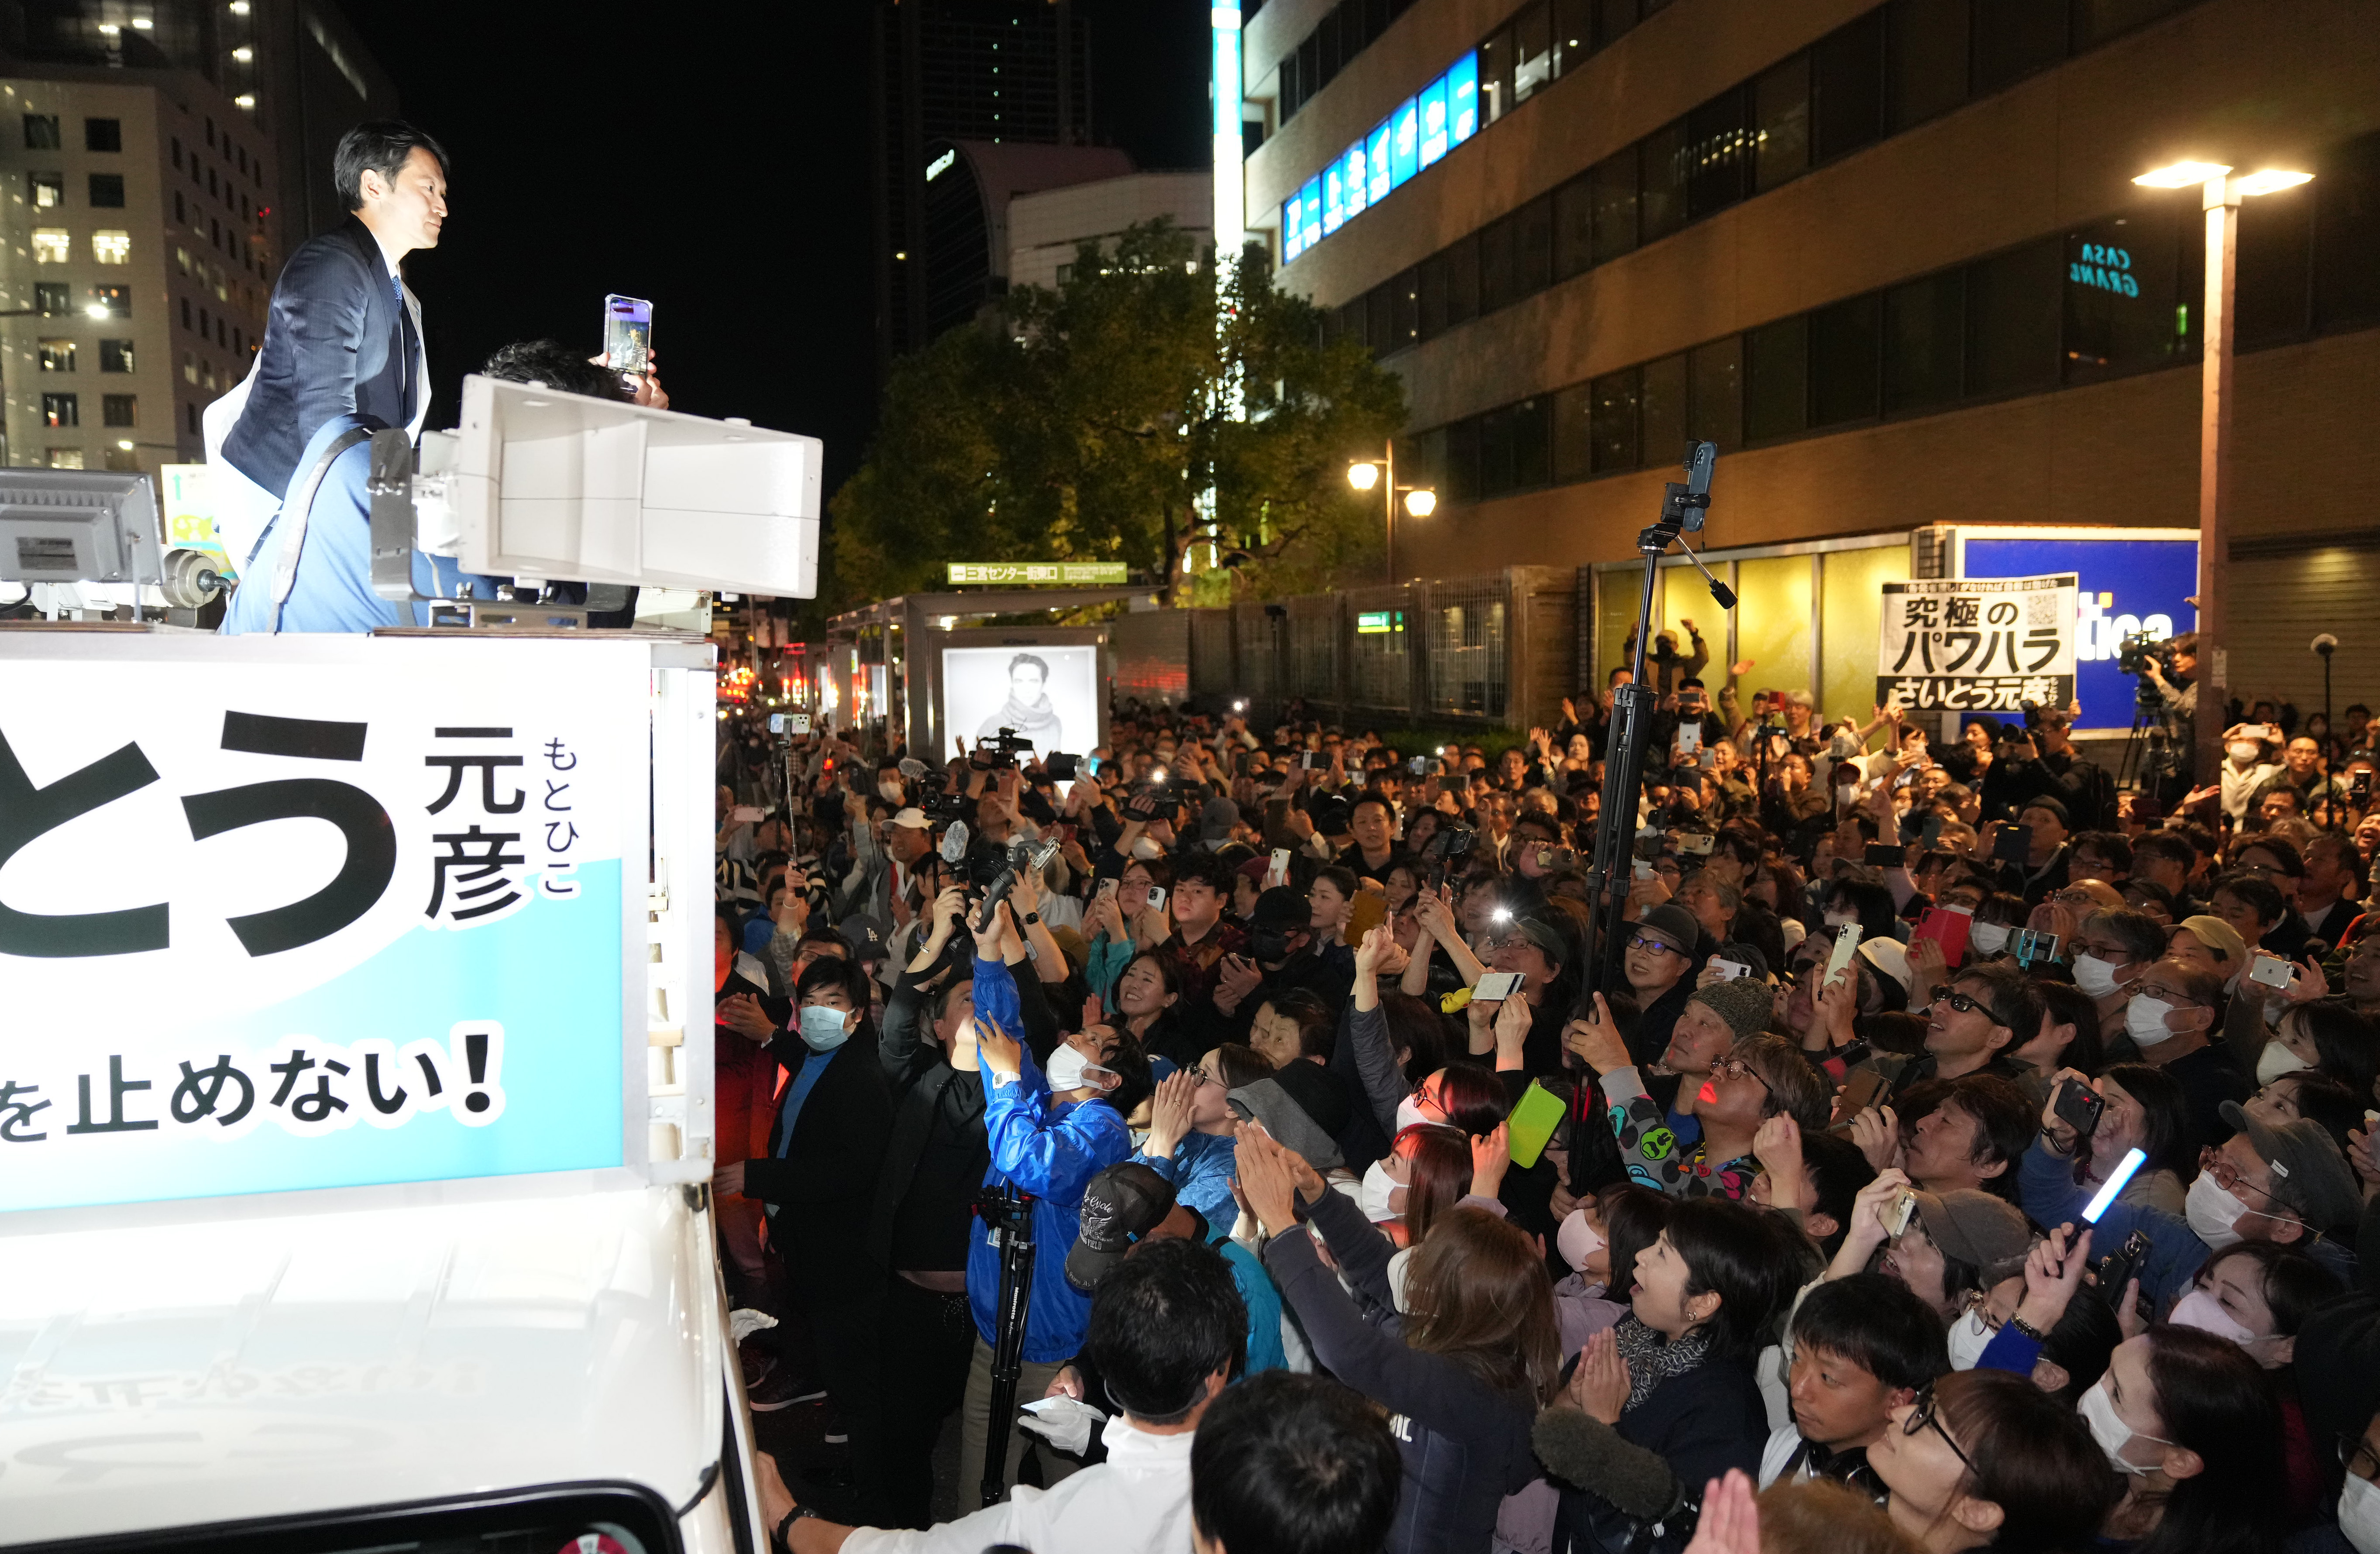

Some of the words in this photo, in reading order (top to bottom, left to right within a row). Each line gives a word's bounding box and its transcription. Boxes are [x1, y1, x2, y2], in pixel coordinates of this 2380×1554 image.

[1903, 597, 2018, 628] 究極の
[1893, 629, 2060, 674] パワハラ
[1895, 676, 2050, 710] さいとう元彦
[425, 727, 526, 921] 元彦
[544, 738, 579, 893] もとひこ
[866, 927, 878, 942] LA
[1010, 1287, 1019, 1319] Manfrotto
